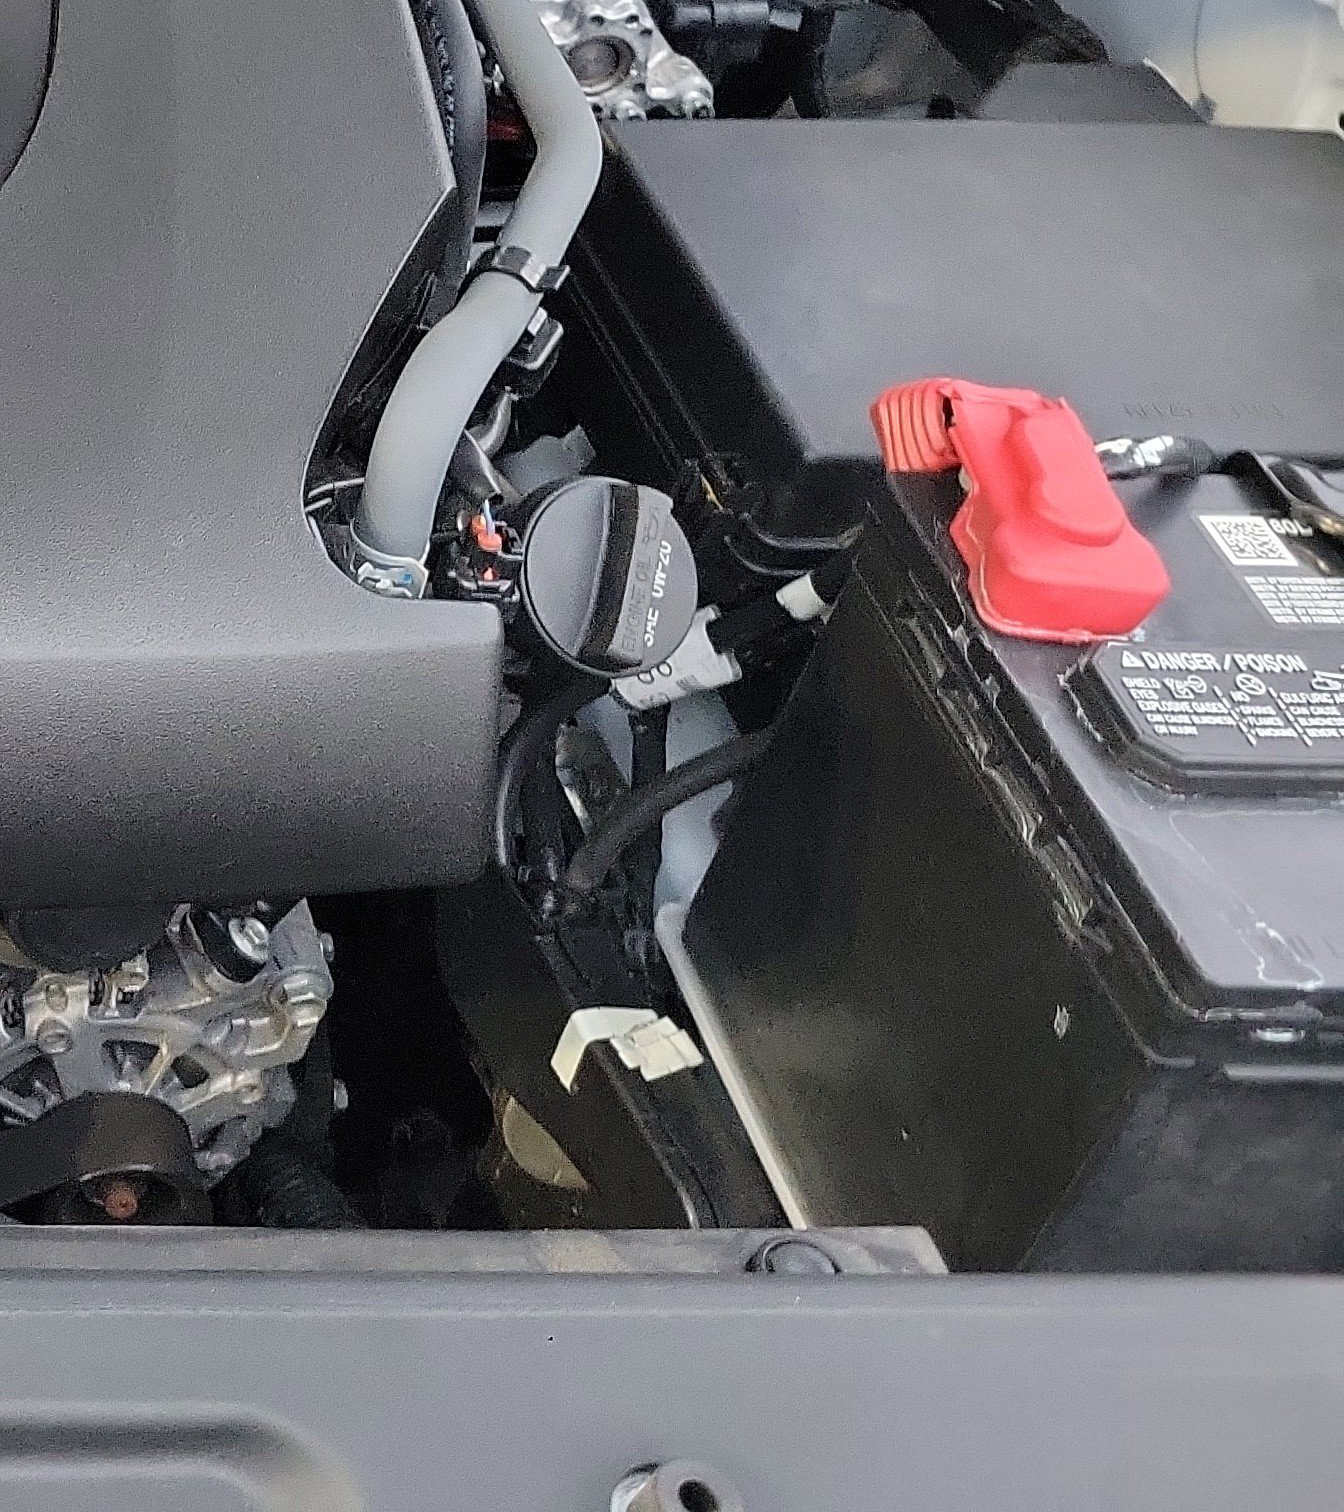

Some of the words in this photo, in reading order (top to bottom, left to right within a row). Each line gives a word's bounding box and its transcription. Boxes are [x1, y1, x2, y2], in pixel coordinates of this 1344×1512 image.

[1141, 650, 1222, 671] DANGER
[1232, 652, 1308, 673] POISON
[1121, 675, 1162, 689] SHIELD
[1128, 688, 1159, 700] EYES
